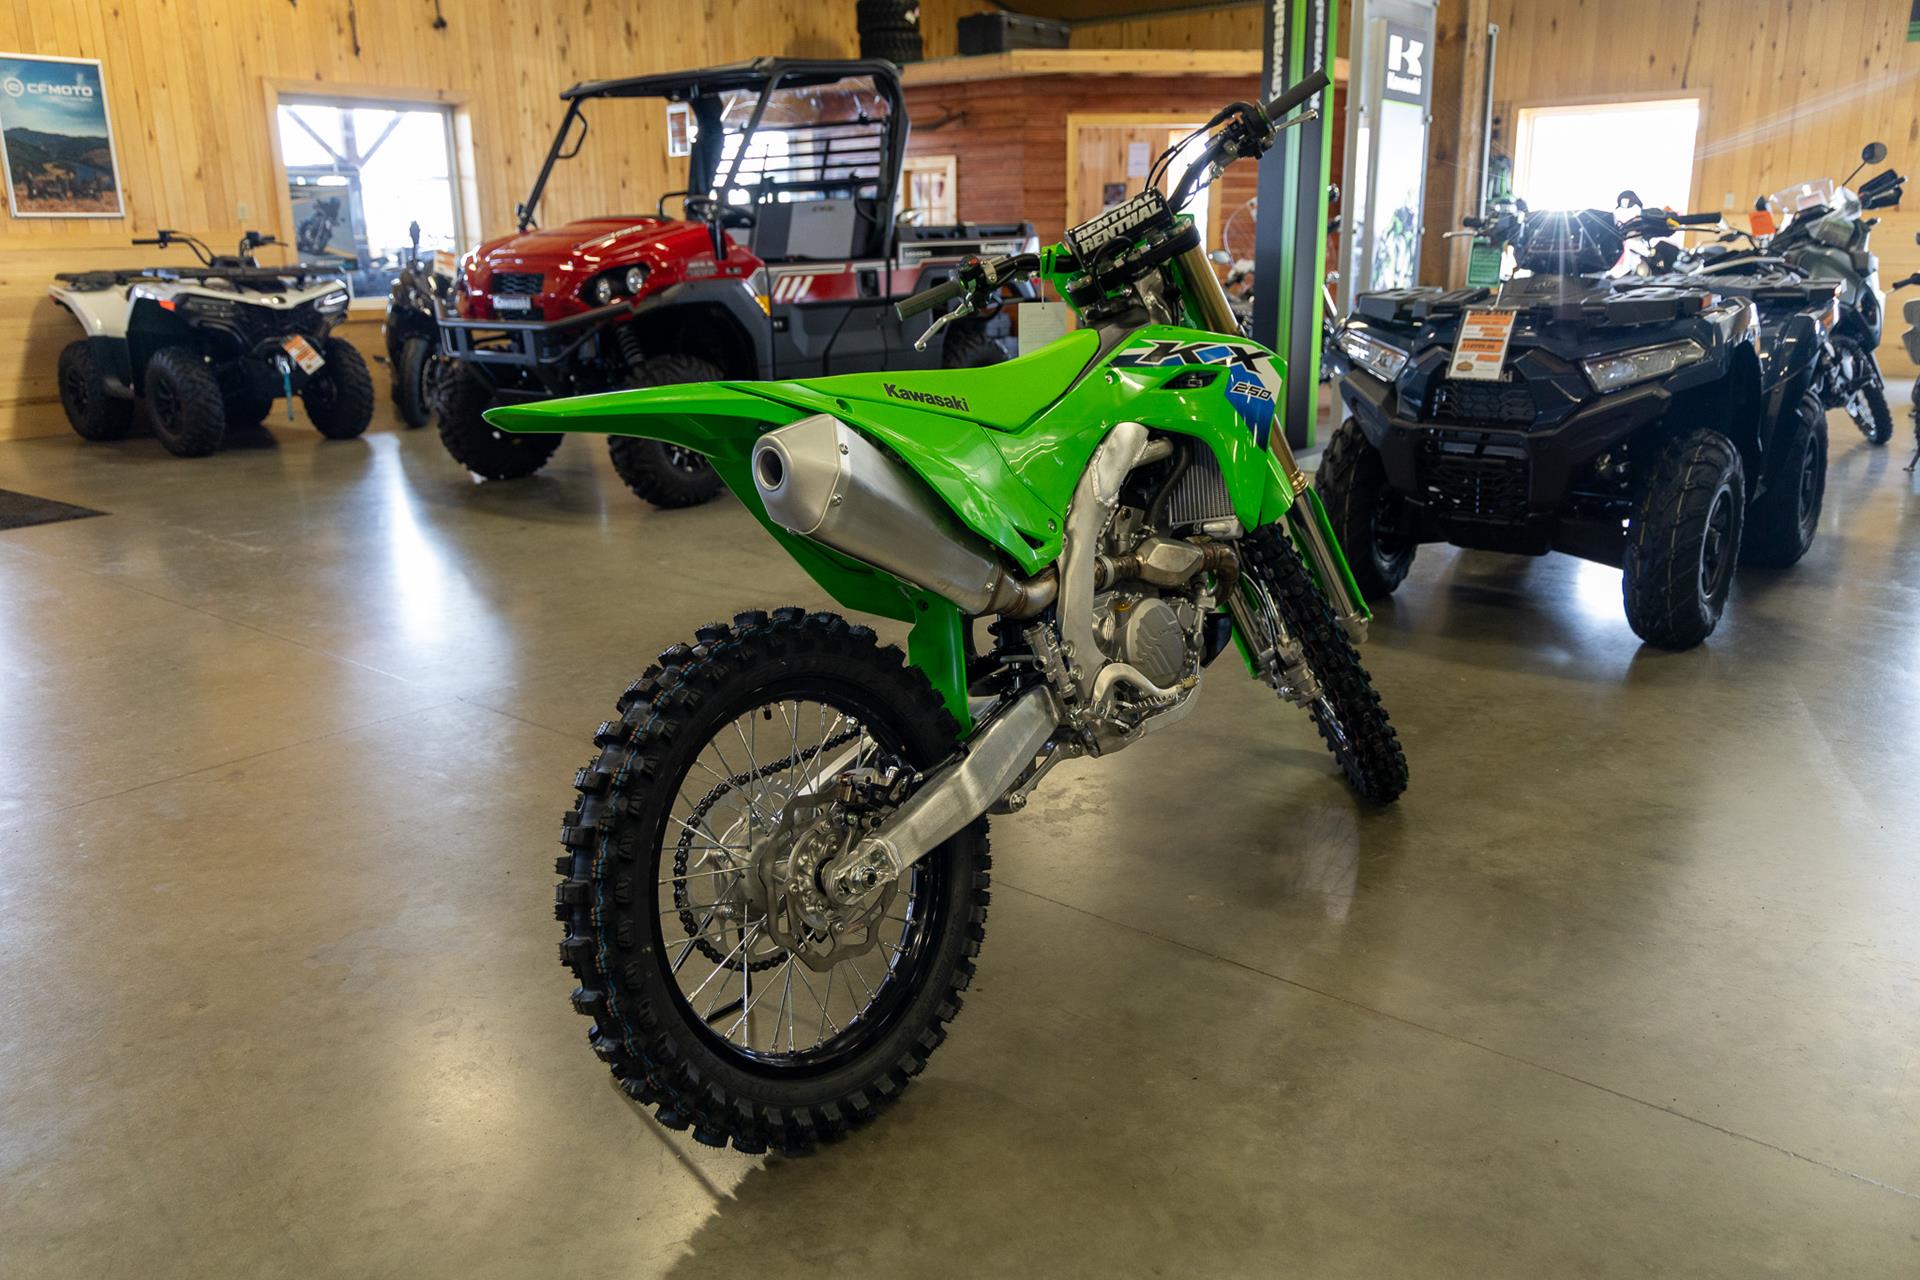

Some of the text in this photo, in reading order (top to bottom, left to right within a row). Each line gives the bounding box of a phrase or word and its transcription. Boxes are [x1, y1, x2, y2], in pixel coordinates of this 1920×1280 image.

[26, 83, 94, 97] CFMOTO
[1074, 192, 1157, 242] RENTHAL
[1079, 200, 1163, 256] RENTHAL
[1133, 340, 1275, 374] KX
[883, 382, 970, 413] Kawasaki
[1230, 381, 1272, 401] 250
